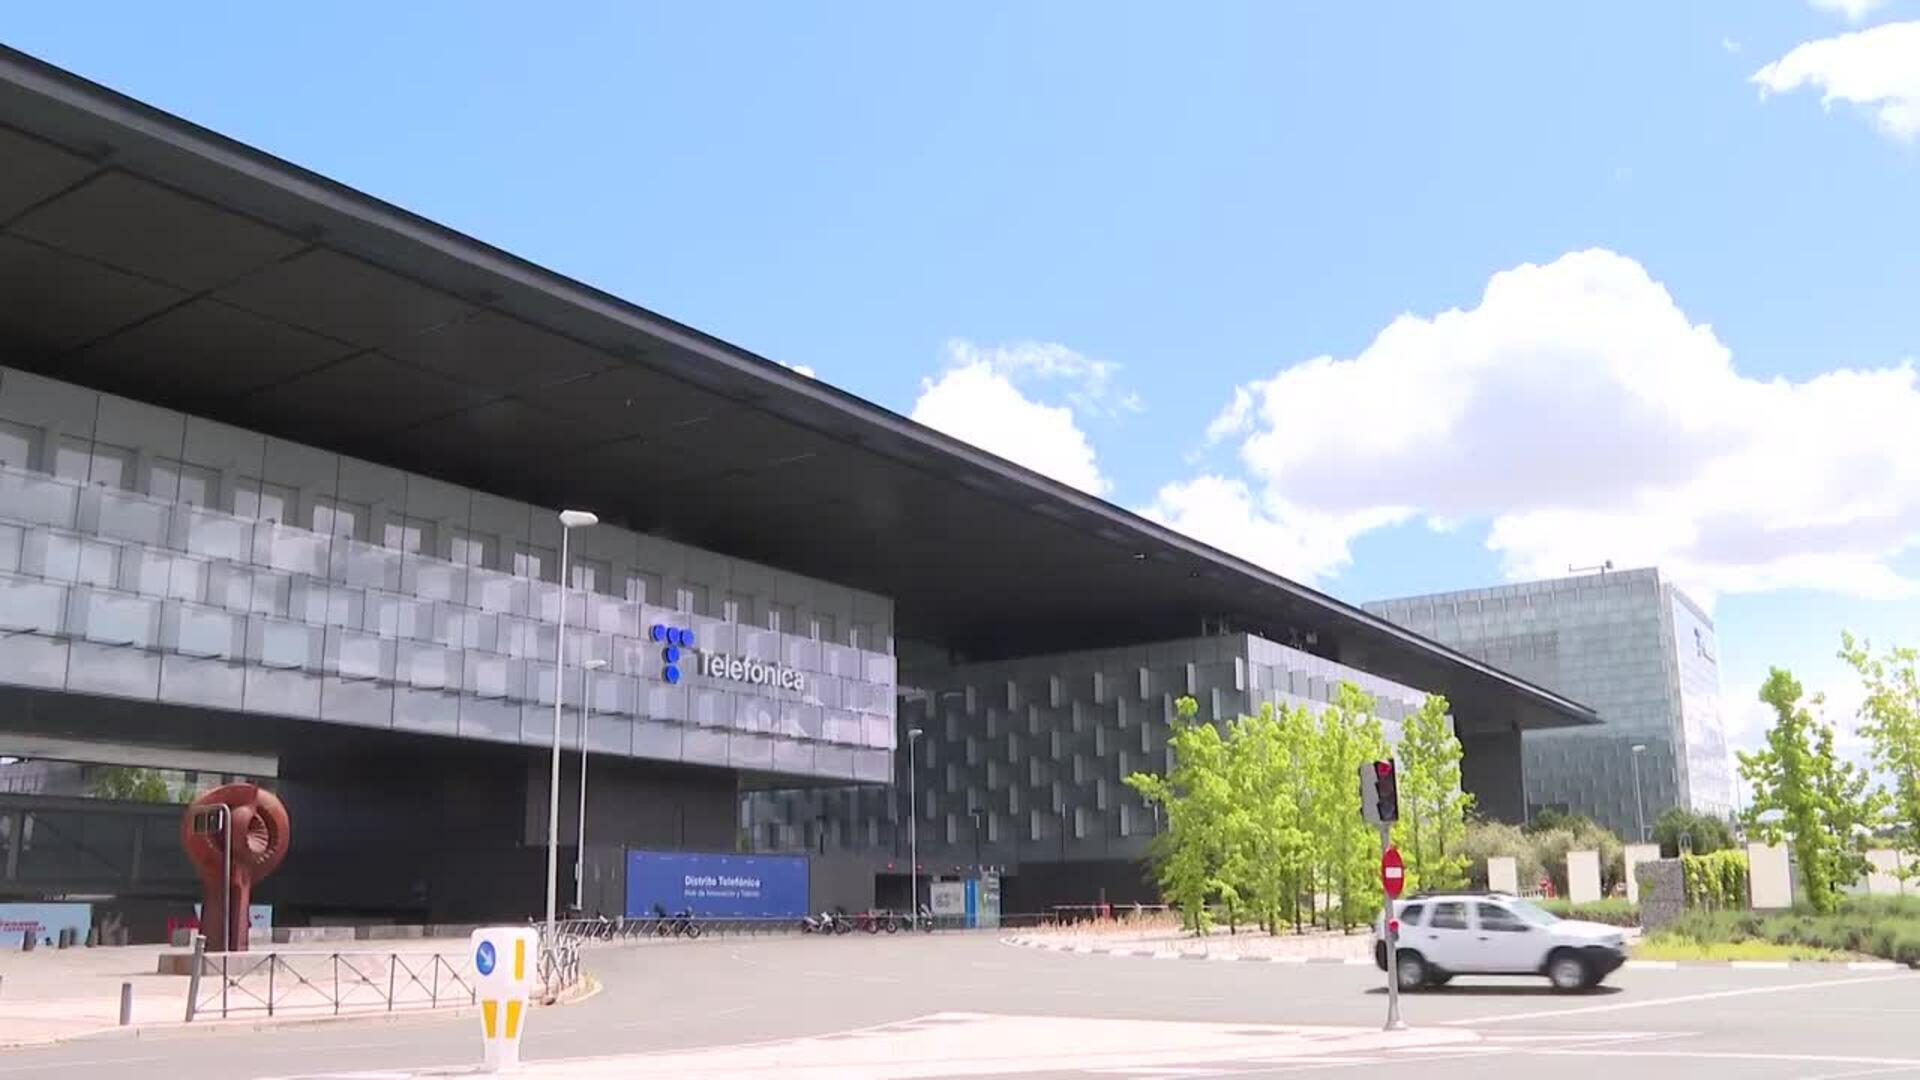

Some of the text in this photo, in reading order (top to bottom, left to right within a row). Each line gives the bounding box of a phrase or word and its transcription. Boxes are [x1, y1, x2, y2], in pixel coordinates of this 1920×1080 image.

[700, 649, 805, 691] Telefónica
[684, 875, 760, 888] Distrito Telefónica
